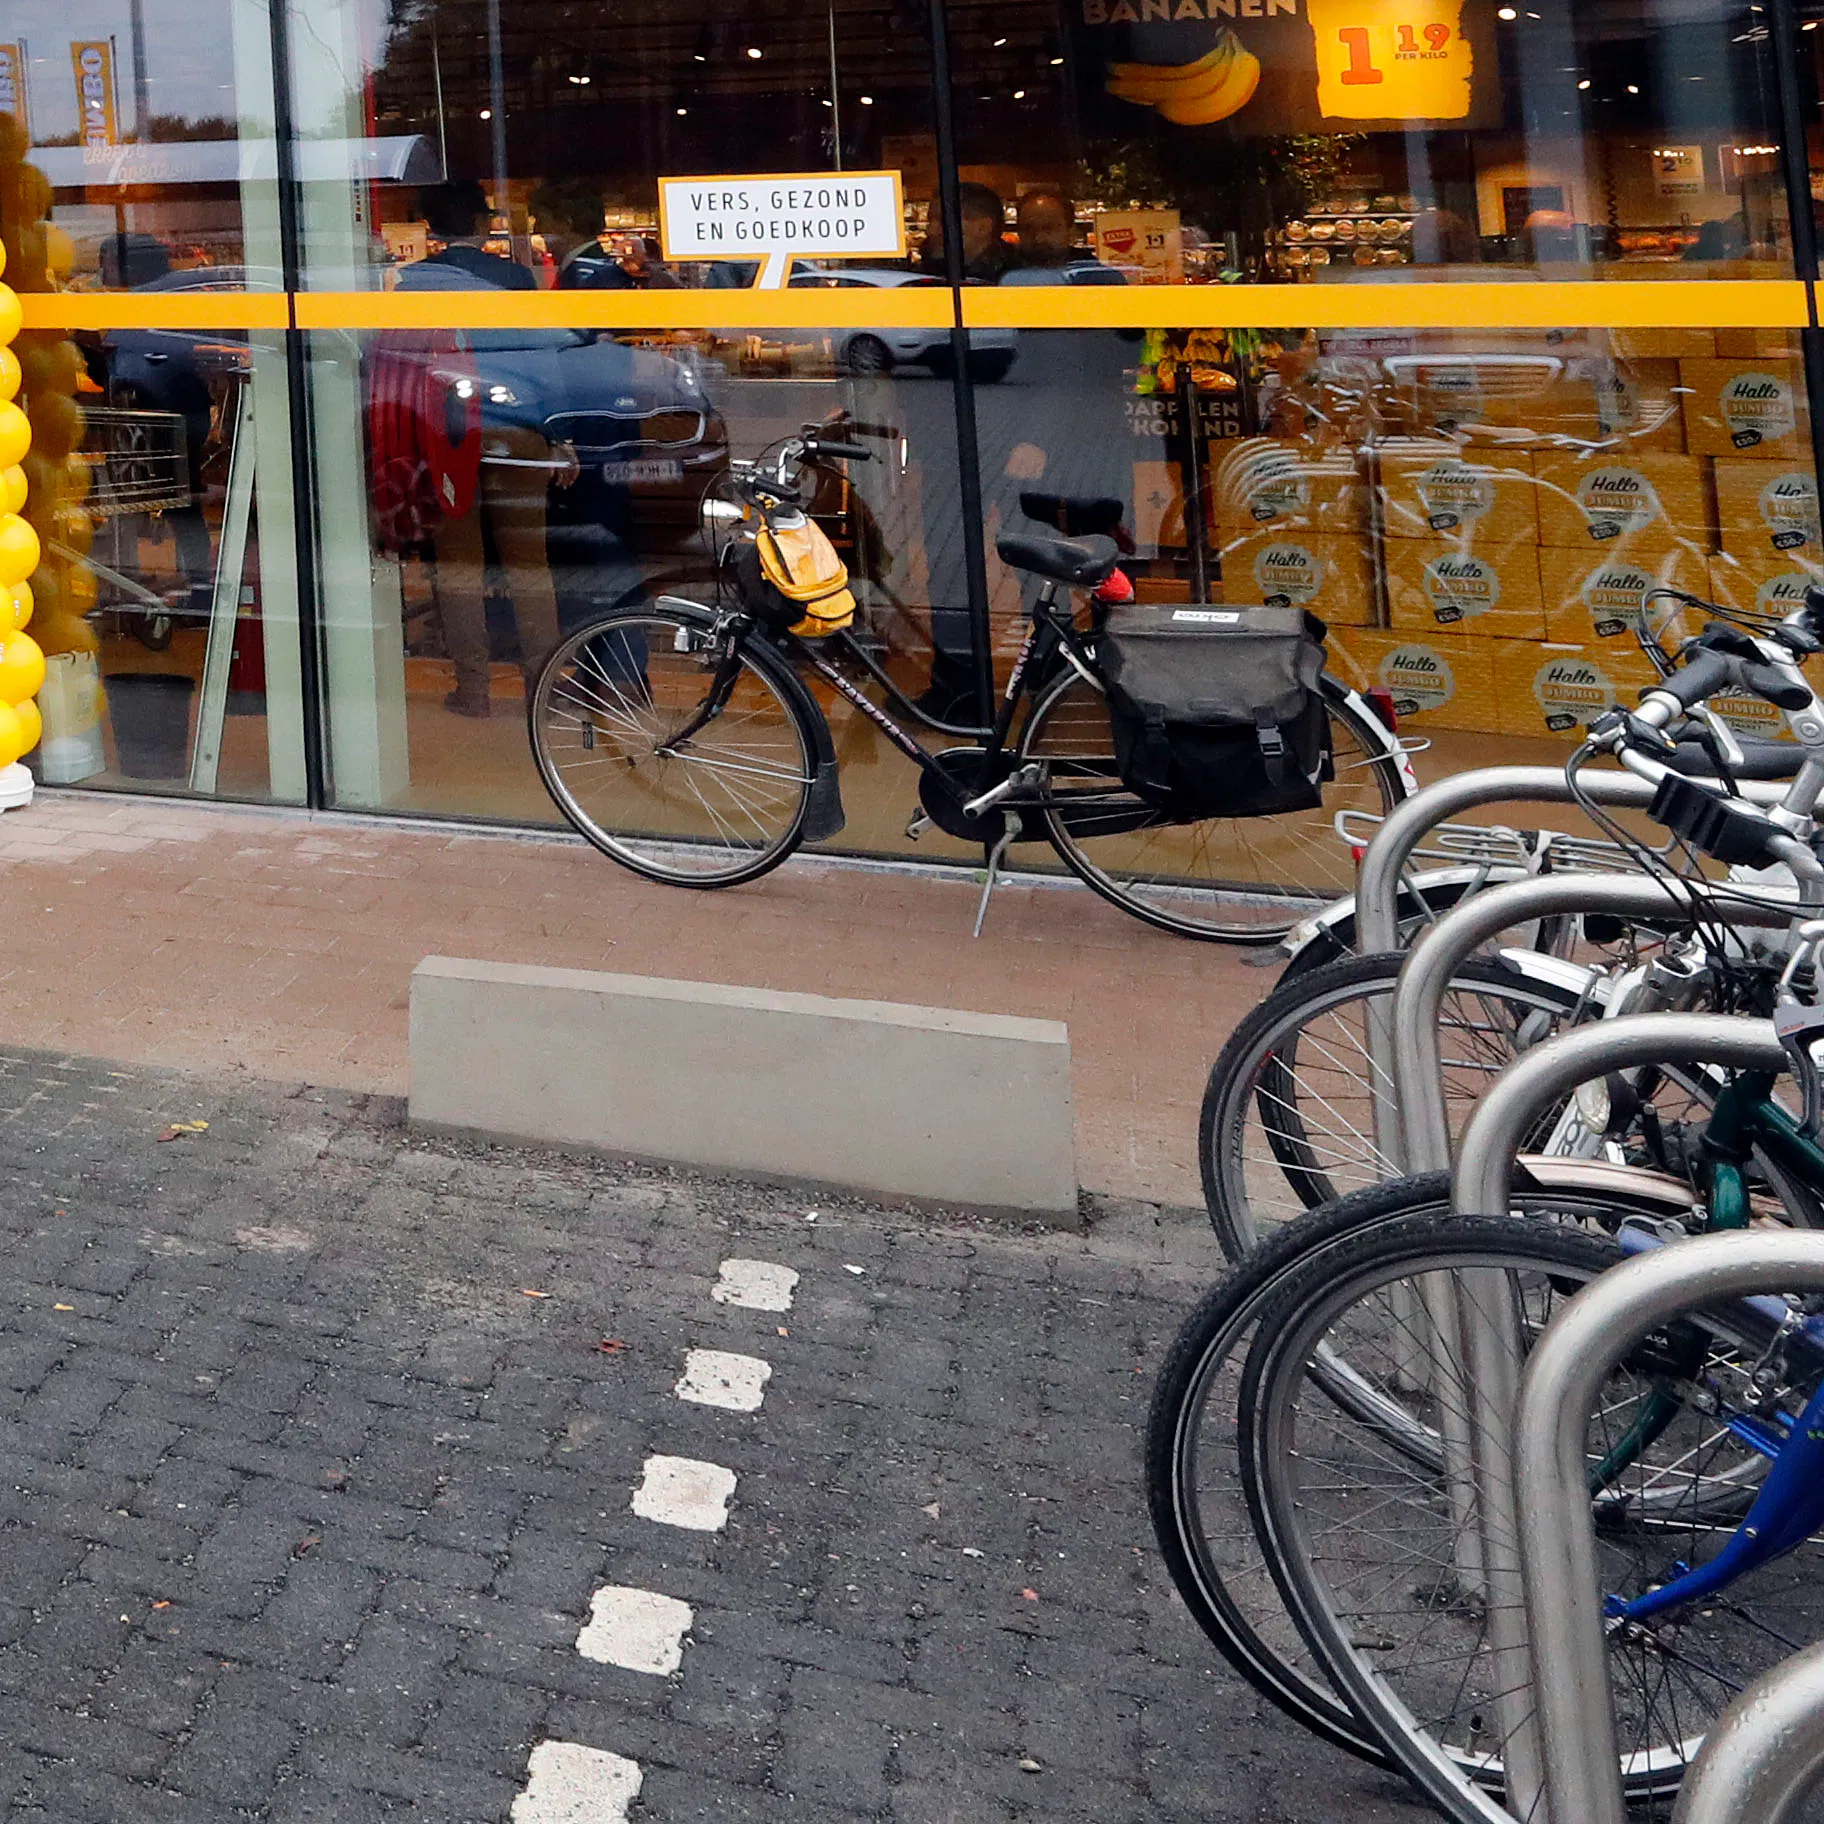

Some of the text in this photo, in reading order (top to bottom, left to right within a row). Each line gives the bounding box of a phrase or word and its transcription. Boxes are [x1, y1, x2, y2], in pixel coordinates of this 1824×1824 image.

[1339, 24, 1450, 85] 1 19
[1394, 51, 1449, 61] PER KILO
[690, 188, 867, 213] VERS, GEZOND
[696, 219, 866, 240] EN GOEDKOOP
[1733, 383, 1780, 398] Hallo
[1591, 476, 1639, 491] Hallo
[1265, 552, 1306, 566] Hallo
[1438, 562, 1482, 578] Hallo
[1596, 574, 1645, 589] Hallo
[1393, 655, 1436, 672] Hallo
[1548, 667, 1596, 684] Hallo
